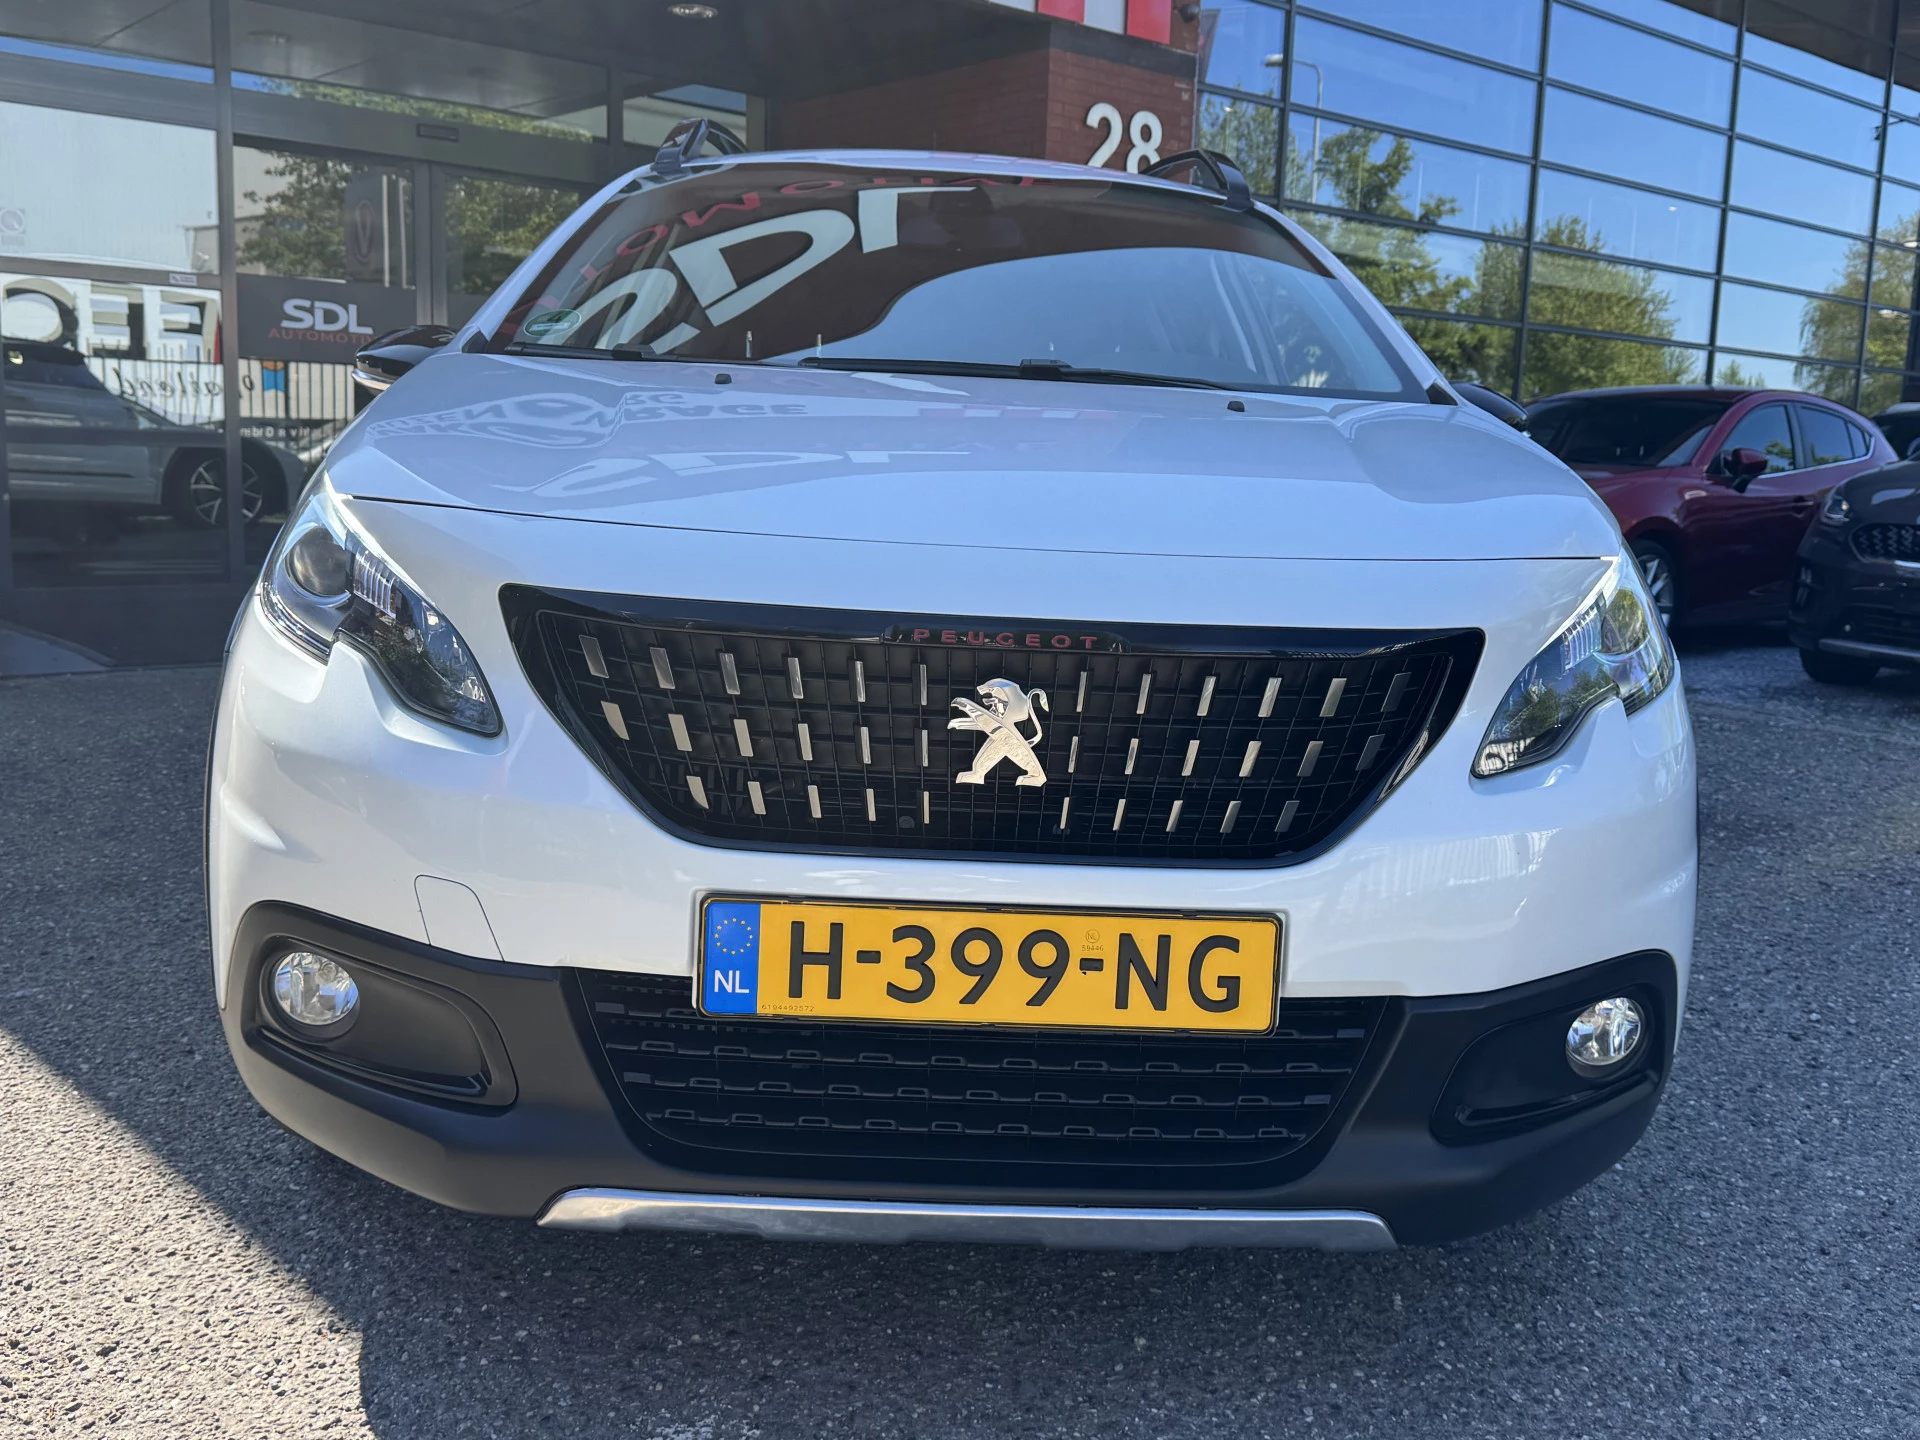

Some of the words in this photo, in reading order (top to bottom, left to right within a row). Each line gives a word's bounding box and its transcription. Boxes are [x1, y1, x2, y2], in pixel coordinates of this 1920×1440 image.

[1086, 103, 1163, 173] 28
[280, 298, 374, 334] SDL
[913, 628, 1098, 649] PEUGEOT
[713, 969, 750, 995] NL
[788, 920, 1241, 1012] H-399-NG
